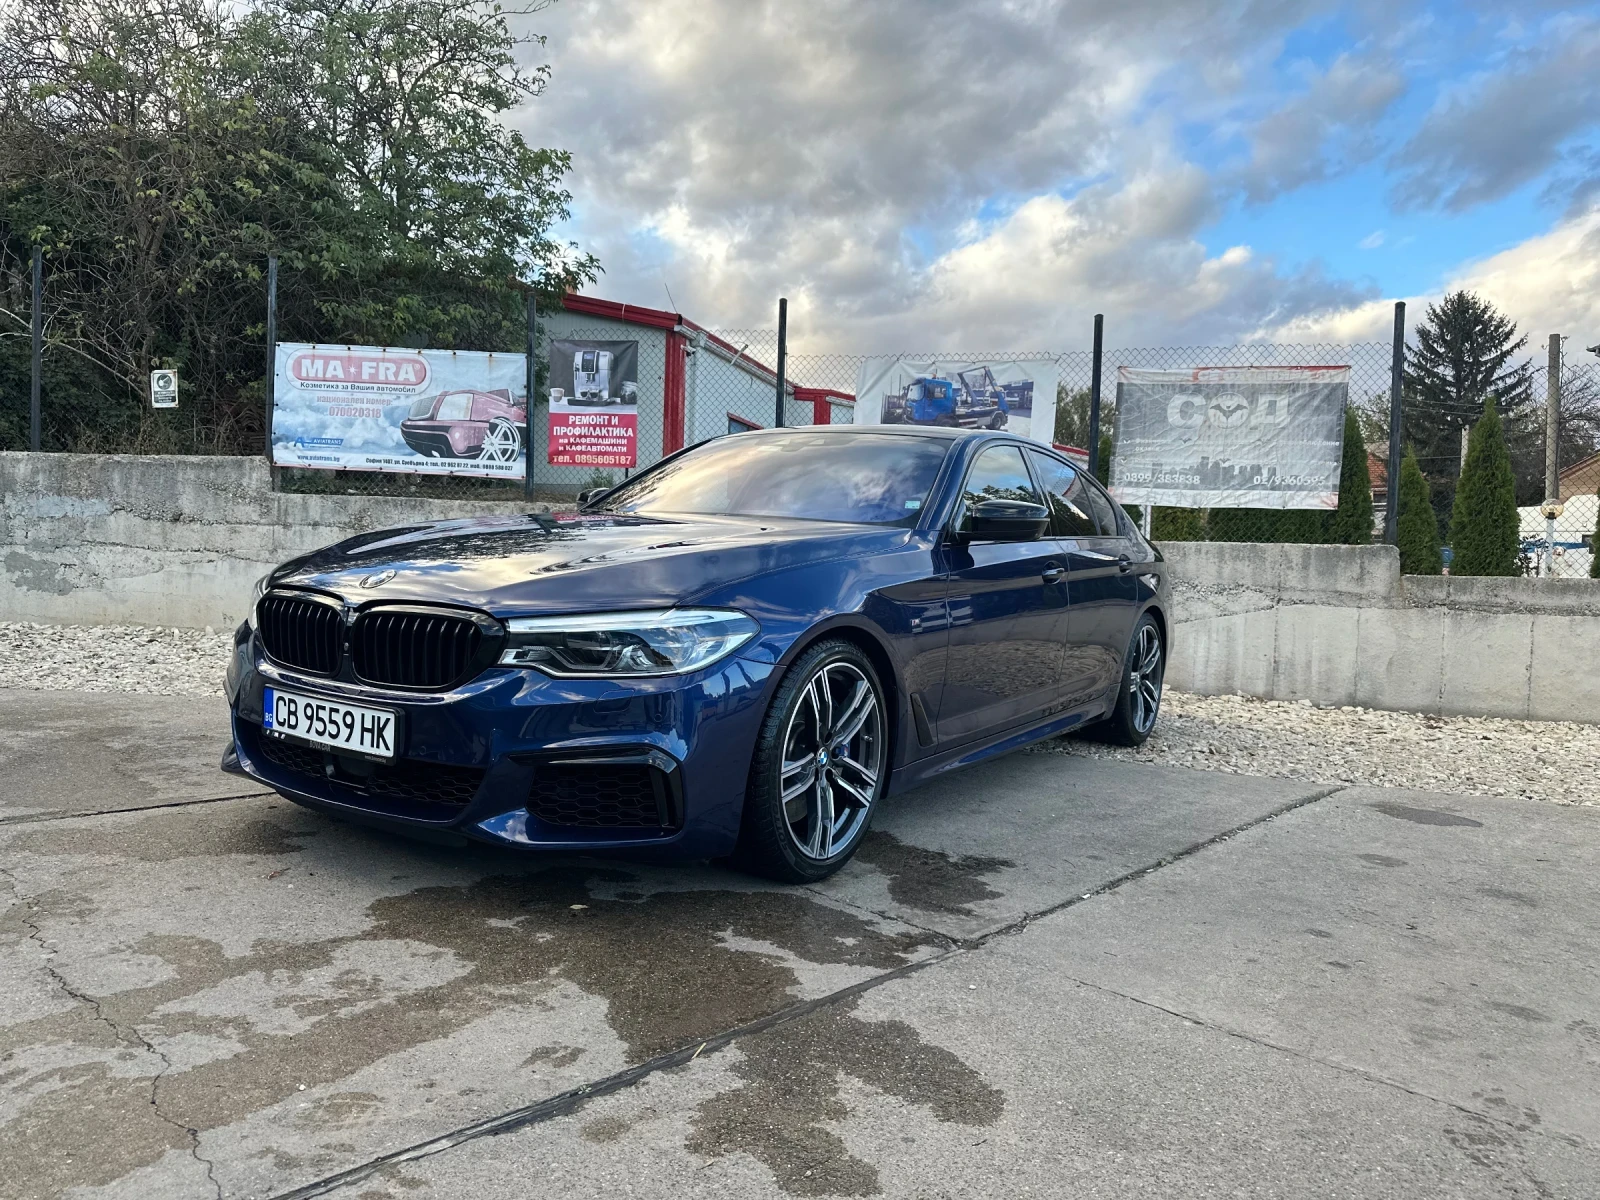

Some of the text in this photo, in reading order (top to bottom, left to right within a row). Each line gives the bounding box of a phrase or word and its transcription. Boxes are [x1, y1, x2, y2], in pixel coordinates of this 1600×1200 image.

[300, 381, 339, 390] Козметика
[350, 384, 375, 392] Вашия
[317, 395, 393, 407] национален номер:
[328, 406, 382, 419] 070020318
[569, 415, 619, 426] РЕМОНТ И
[553, 426, 634, 437] ПРОФИЛАКТИКА
[569, 437, 628, 445] КАФЕМАШИНИ
[565, 445, 627, 453] КАФЕАВТОМАТИ
[553, 454, 632, 465] тел. 0895605187
[264, 712, 273, 723] BG
[275, 695, 391, 751] CB 9559 HK
